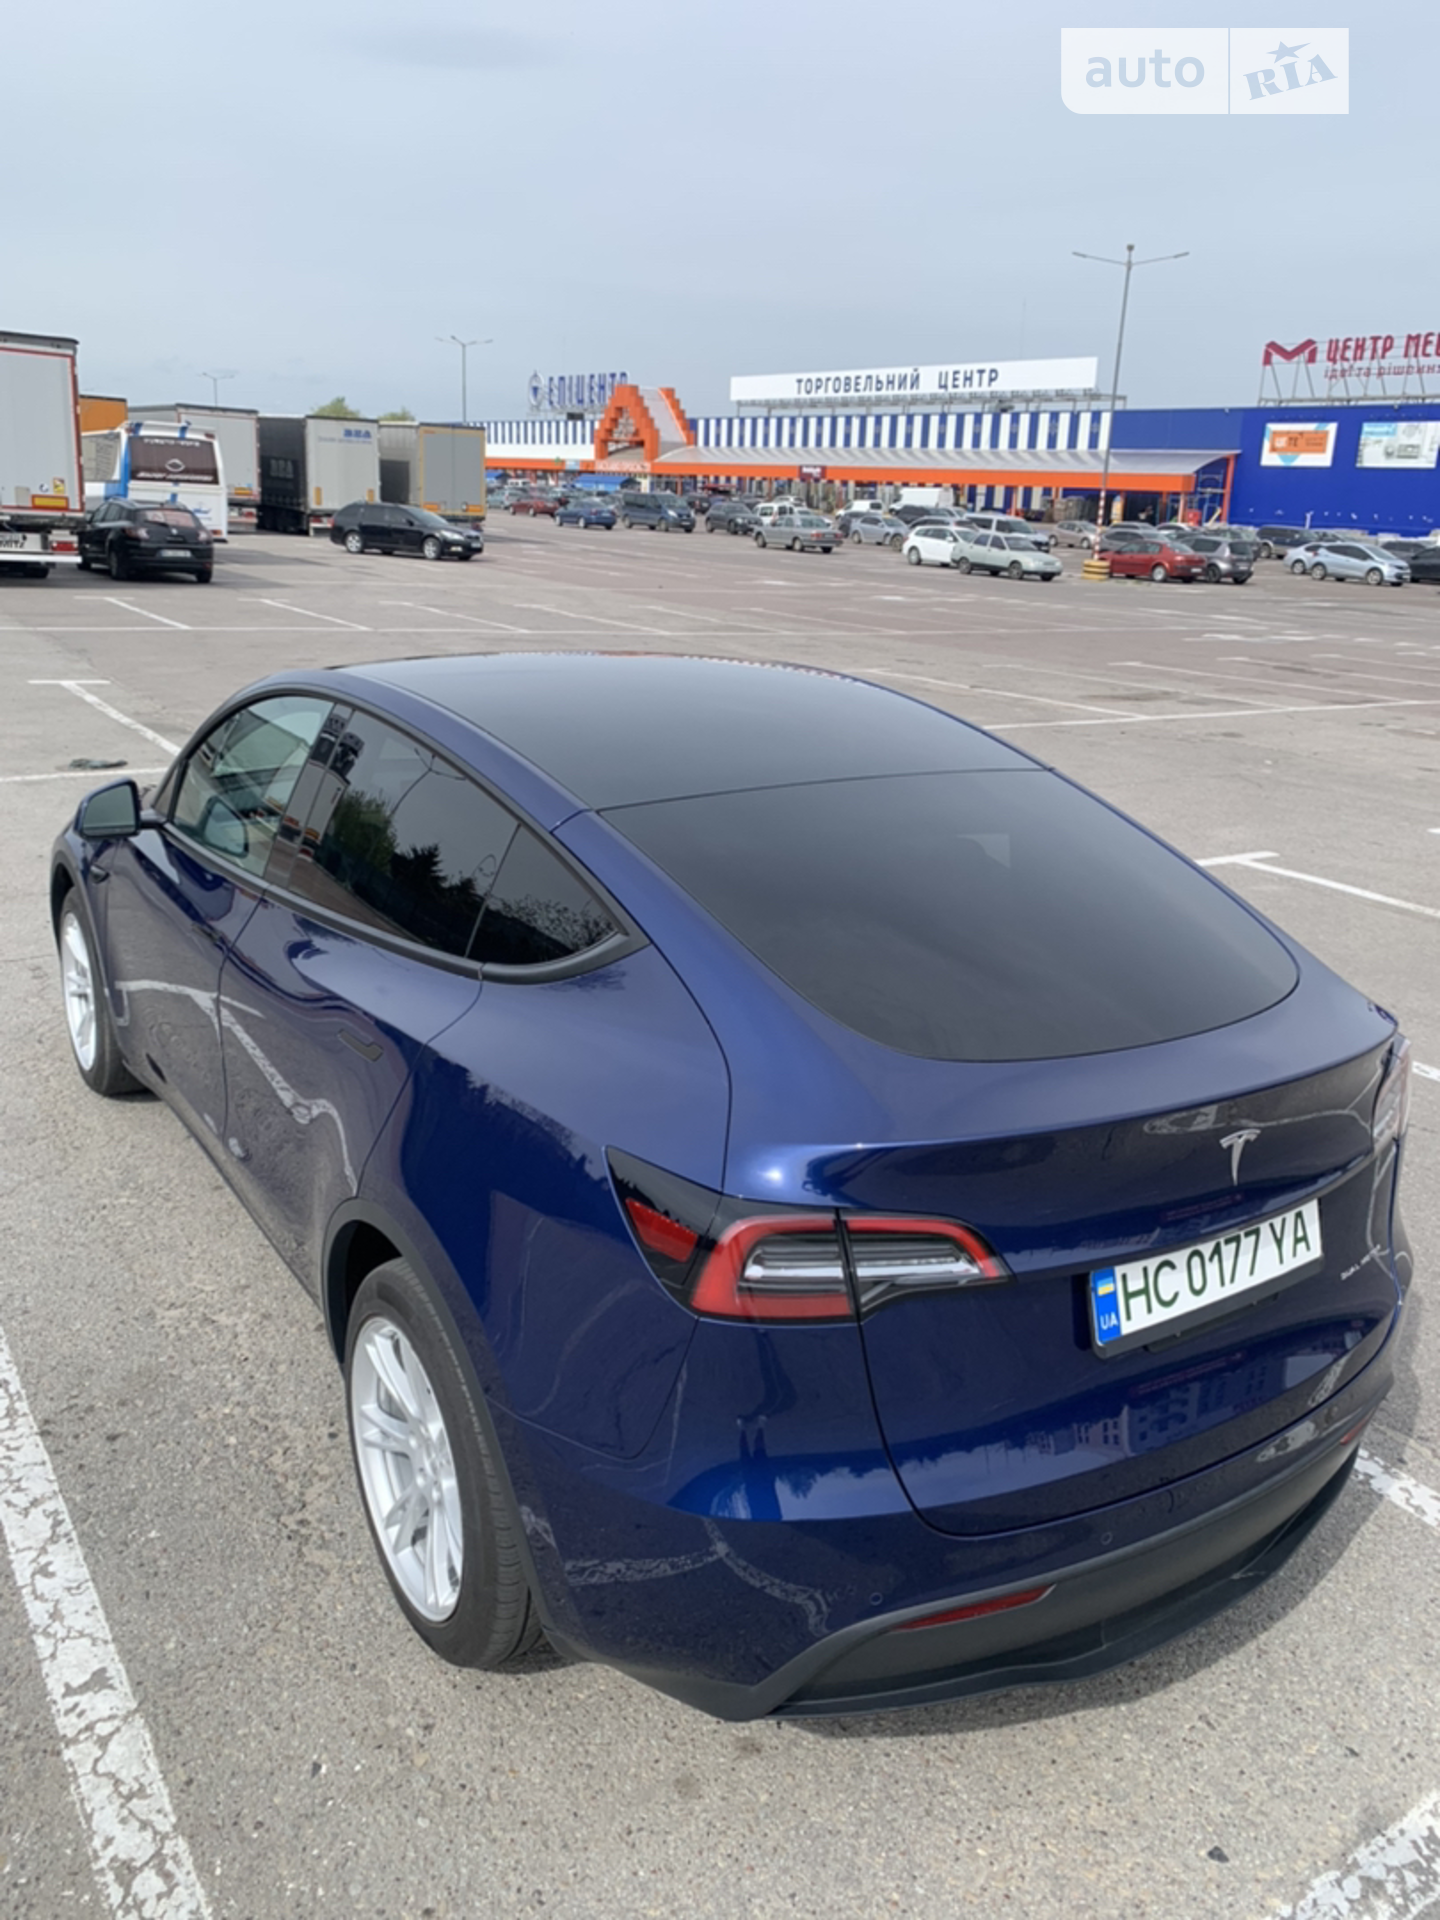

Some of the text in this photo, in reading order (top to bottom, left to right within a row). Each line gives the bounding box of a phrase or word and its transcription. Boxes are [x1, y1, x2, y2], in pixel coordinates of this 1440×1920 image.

[1326, 331, 1440, 365] ЦЕНТР МЕ
[795, 368, 1000, 395] ТОРГОВЕЛЬНИЙ ЦЕНТР
[1120, 1210, 1311, 1322] HC 0177 YA
[1100, 1311, 1119, 1331] UA
